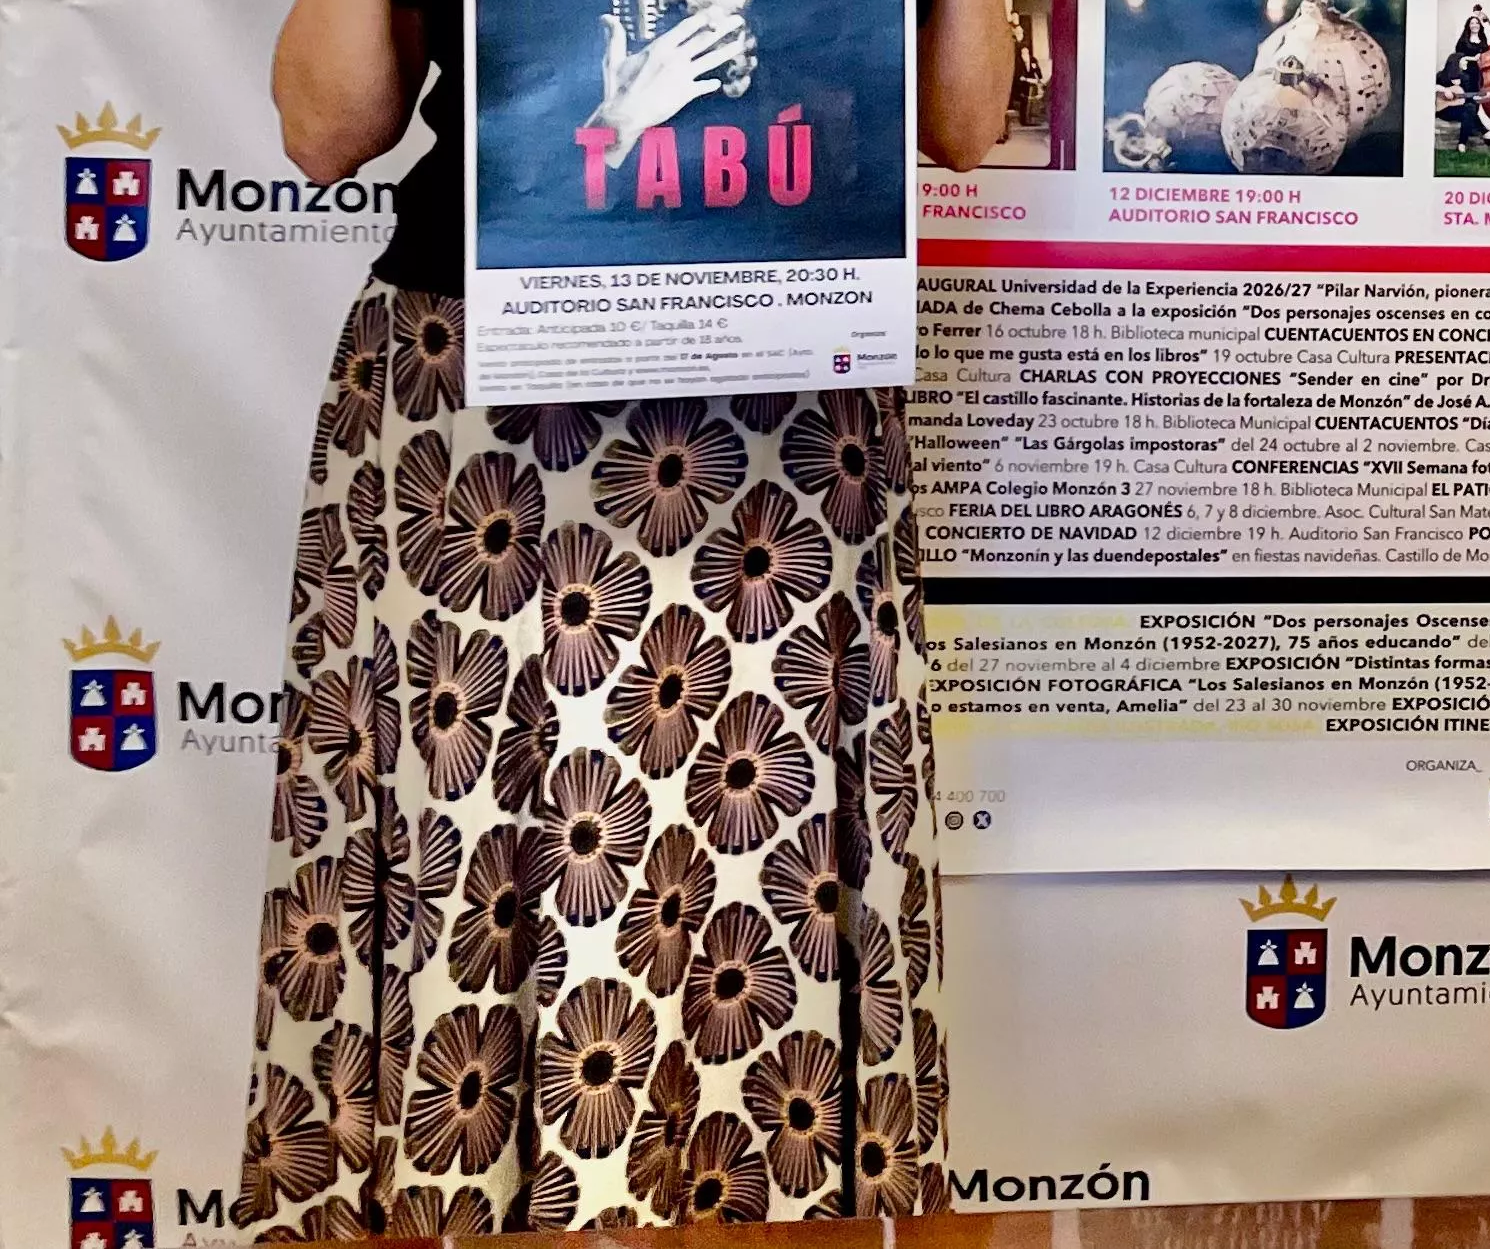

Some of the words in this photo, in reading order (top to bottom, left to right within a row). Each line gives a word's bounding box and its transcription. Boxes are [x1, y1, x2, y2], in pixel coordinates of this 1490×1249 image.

[574, 102, 813, 210] TABÚ
[520, 274, 606, 291] VIERNES,
[611, 274, 631, 288] 13
[637, 273, 661, 287] DE
[666, 269, 782, 286] NOVIEMBRE,
[786, 268, 838, 283] 20:30
[843, 268, 860, 281] H.
[502, 298, 612, 315] AUDITORIO
[617, 297, 656, 311] SAN
[660, 294, 773, 310] FRANCISCO
[786, 291, 873, 307] MONZON
[1304, 550, 1381, 562] navideñas.
[1386, 549, 1438, 562] Castillo
[1443, 550, 1462, 562] de
[1326, 712, 1439, 732] EXPOSICIÓN
[948, 1162, 1150, 1203] Monzón
